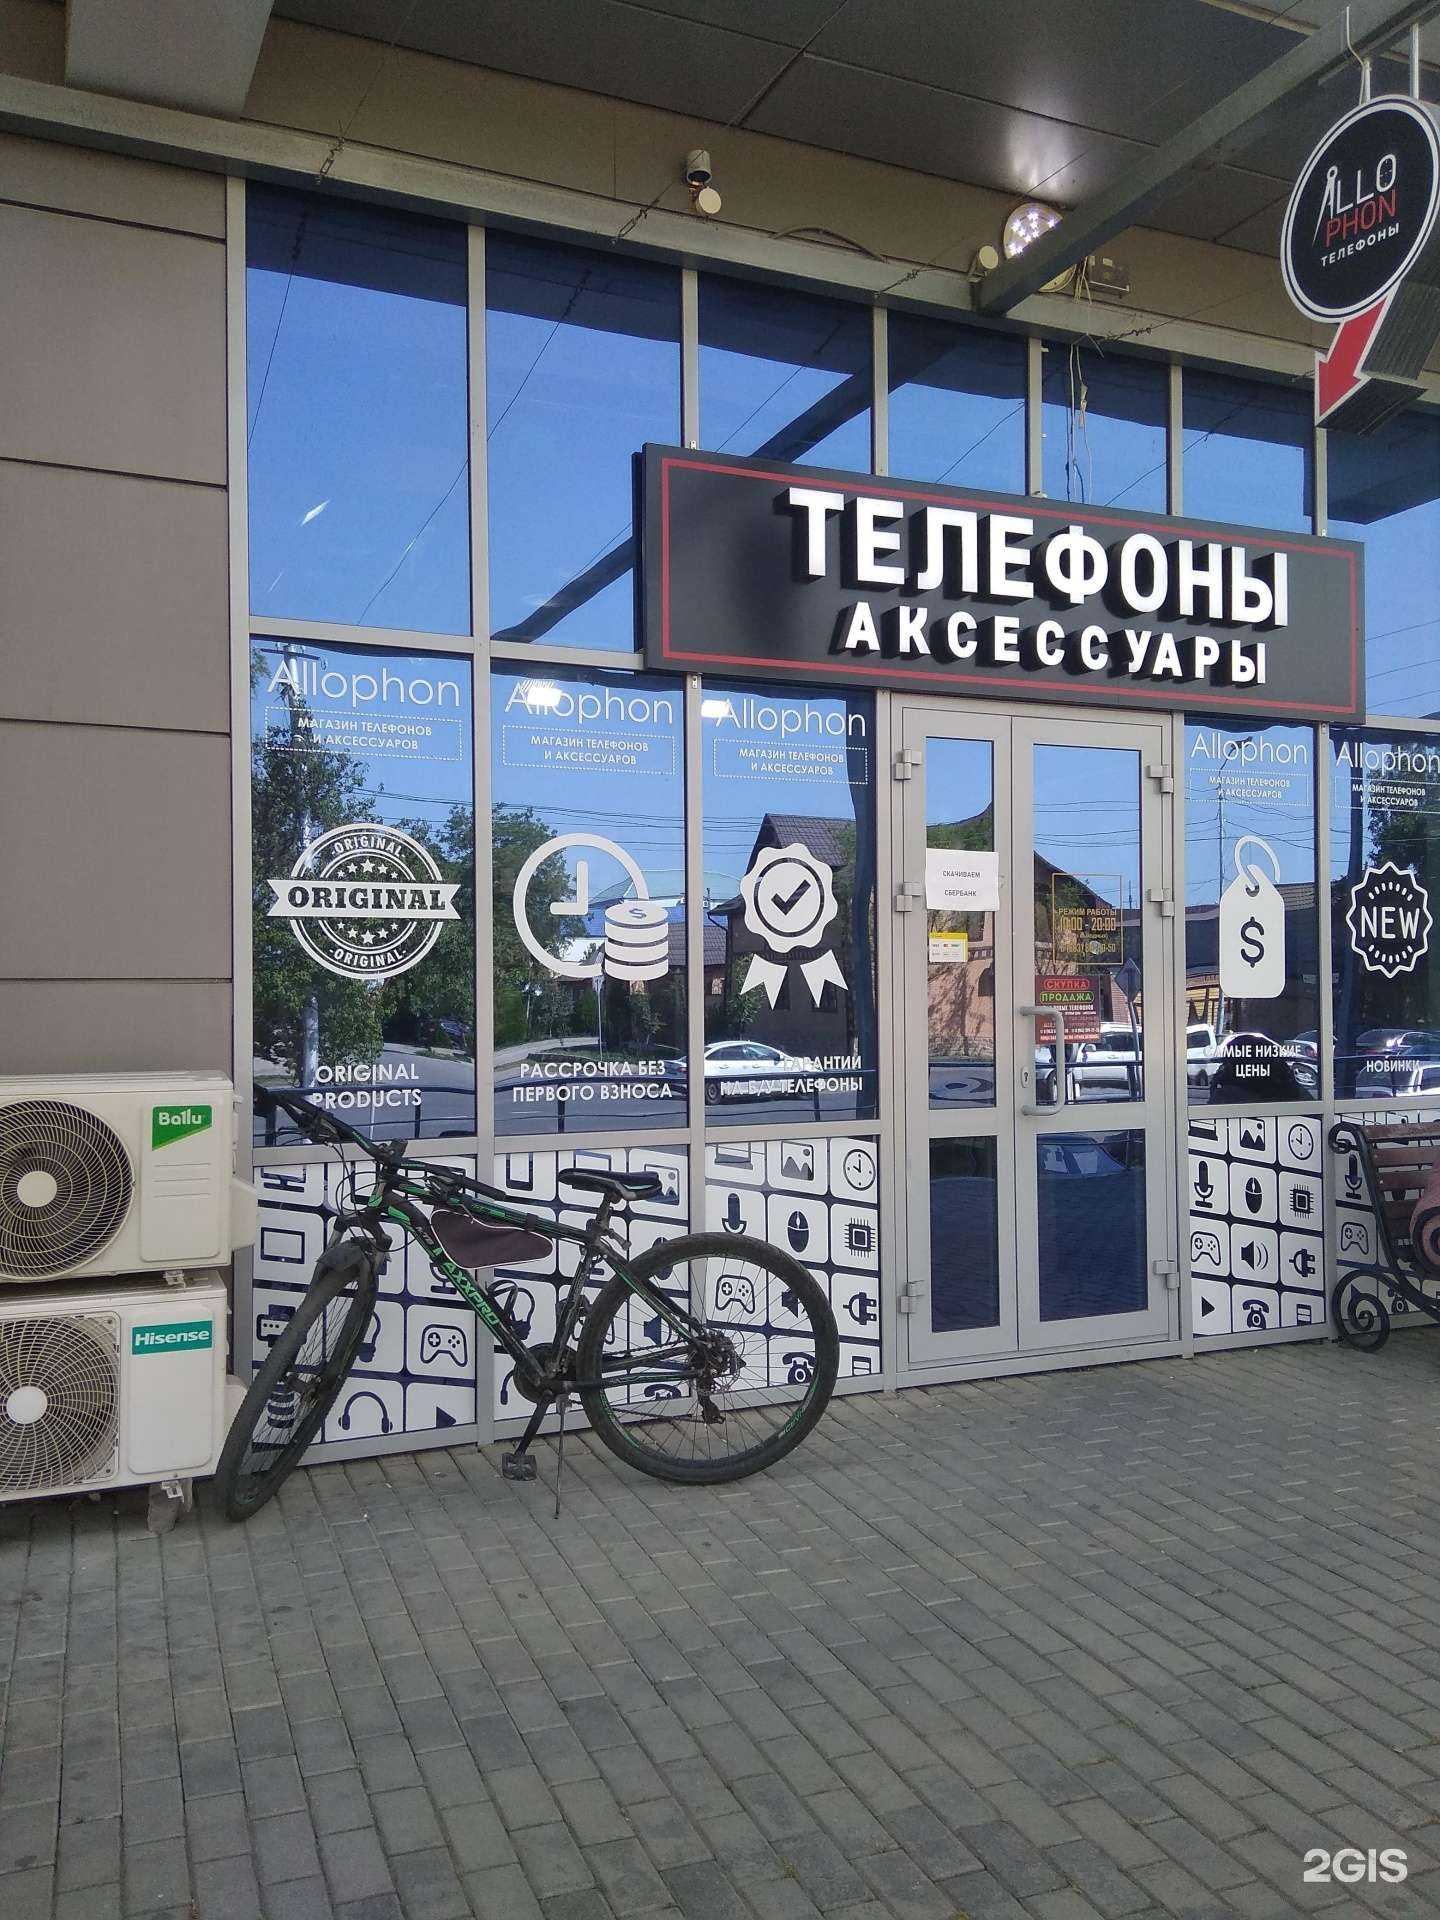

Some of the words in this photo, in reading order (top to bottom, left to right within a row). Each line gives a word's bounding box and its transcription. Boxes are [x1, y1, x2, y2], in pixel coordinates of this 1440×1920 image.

[1312, 154, 1397, 246] ALLO
[1326, 188, 1397, 248] PHON
[1320, 222, 1400, 267] ТЕЛЕФОНЫ
[788, 487, 1289, 628] ТЕЛЕФОНЫ
[844, 601, 1266, 685] АКСЕССУАРЫ
[267, 659, 460, 707] Allophon
[505, 682, 673, 724] Aophon
[298, 717, 358, 731] МАГАЗИН
[362, 721, 432, 736] ТЕЛЕФОНОВ
[716, 699, 866, 739] Allophon
[313, 734, 321, 744] И
[326, 734, 418, 750] АКСЕССУАРОВ
[531, 735, 583, 748] МАГАЗИН
[586, 739, 649, 752] ТЕЛЕФОНОВ
[1190, 732, 1308, 766] Allophon
[544, 750, 552, 760] И
[555, 751, 637, 765] АКСЕССУАРОВ
[739, 748, 786, 760] МАГАЗИН
[788, 751, 844, 763] ТЕЛЕФОНОВ
[751, 762, 759, 772] И
[761, 763, 834, 776] АКСЕССУАРОВ
[1209, 776, 1245, 786] МАГАЗИН
[1247, 778, 1290, 788] ТЕЛЕФОНОВ
[1352, 783, 1386, 794] МАГАЗИН
[1386, 785, 1426, 796] ТЕЛЕФОНОВ
[1218, 788, 1225, 797] И
[1225, 788, 1282, 799] АКСЕССУАРОВ
[1367, 796, 1419, 807] АКСЕССУАРОВ
[942, 870, 981, 879] СКАЧИВАЕМ
[287, 886, 446, 911] ORIGINAL
[944, 889, 977, 897] СБЕРБАНК
[1058, 907, 1085, 916] РЕЖИМ
[1087, 908, 1117, 916] РАБОТЫ
[1091, 917, 1116, 931] 20:00
[1361, 905, 1420, 940] NEW
[1046, 980, 1087, 989] СКУПКА
[1041, 993, 1092, 1002] ПРОДАЖА
[1255, 1044, 1301, 1058] НИЗКИЕ
[315, 1063, 420, 1083] ORIGINAL
[519, 1061, 633, 1078] РАССРОЧКА
[638, 1060, 666, 1076] БЕЗ
[1235, 1064, 1270, 1078] ЦЕНЫ
[1366, 1060, 1420, 1073] НОВИНКИ
[513, 1085, 595, 1103] ПЕРВОГО
[600, 1083, 673, 1100] ВЗНОСА
[778, 1077, 863, 1094] ТЕЛЕФОНЫ
[312, 1088, 422, 1109] PRODUCTS
[158, 1109, 203, 1126] Ballu
[134, 1329, 210, 1346] Hisense
